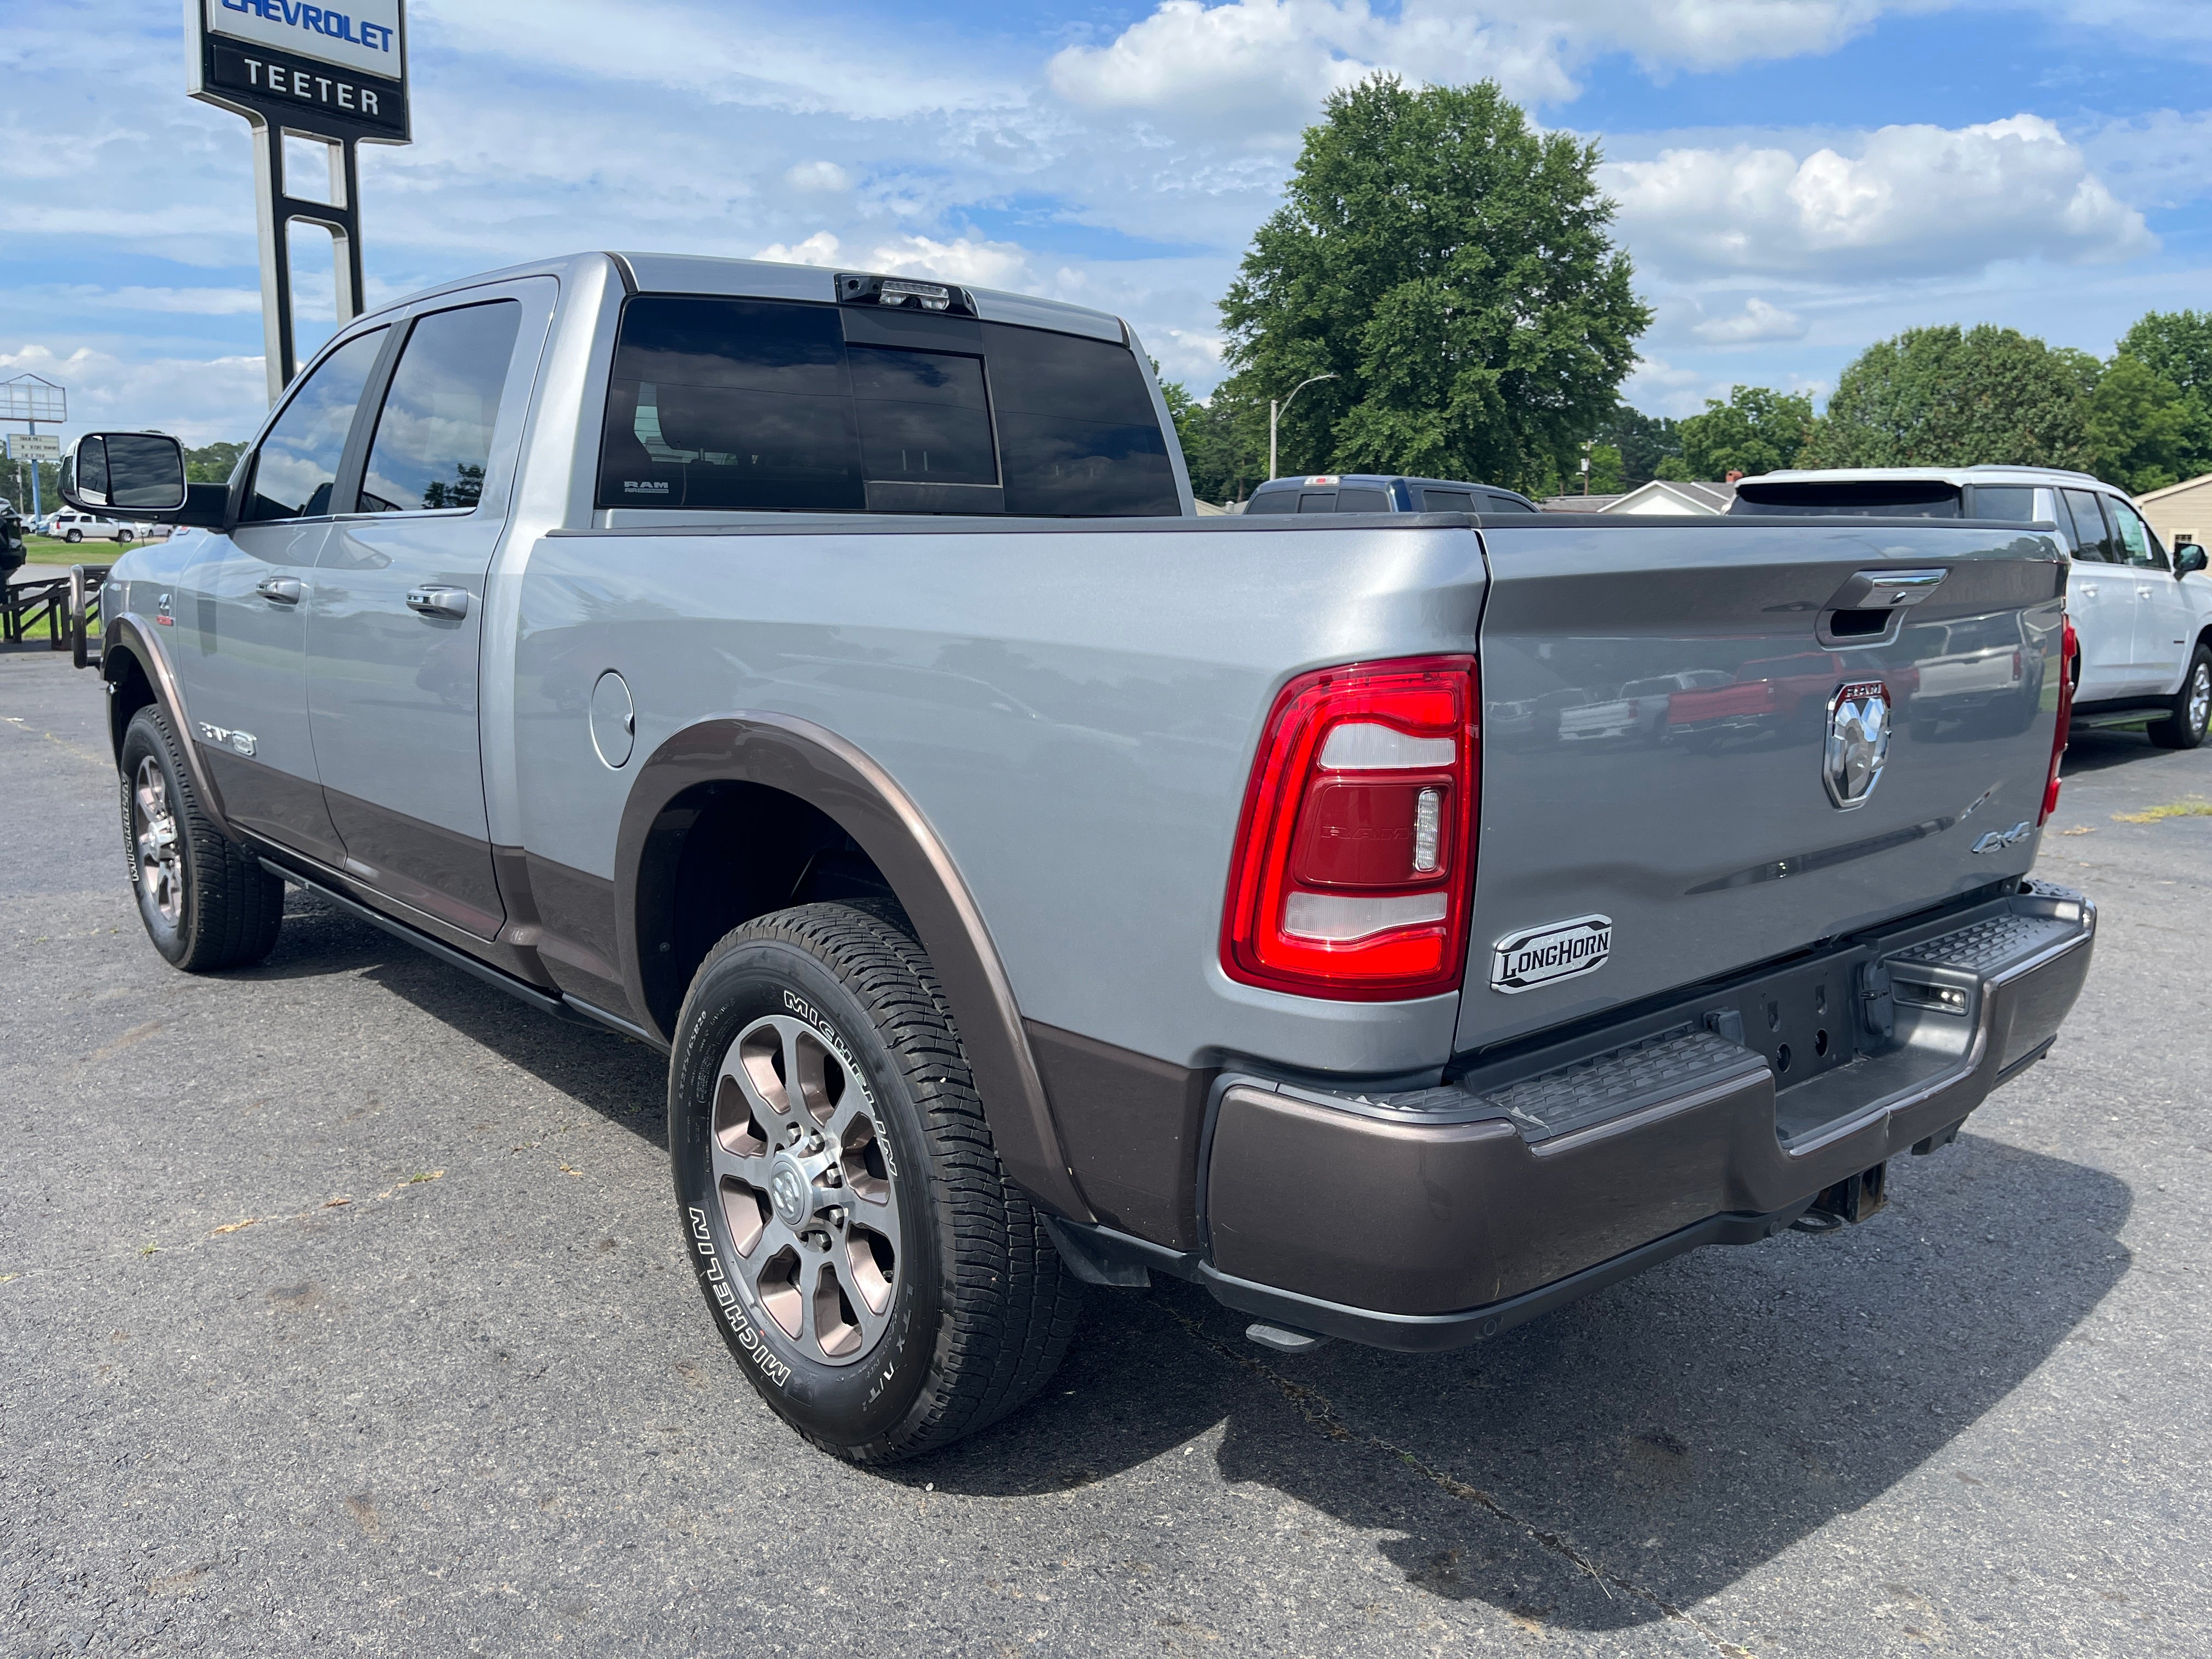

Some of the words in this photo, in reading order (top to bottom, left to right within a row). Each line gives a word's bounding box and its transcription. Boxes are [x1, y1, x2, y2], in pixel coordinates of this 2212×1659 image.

[244, 59, 379, 116] TEETER
[1846, 684, 1882, 697] RAM
[1321, 826, 1410, 840] RAM
[1500, 931, 1610, 980] LONGHORN
[1532, 928, 1587, 947] LIMITED
[783, 990, 898, 1177] MICHELIN
[689, 1207, 791, 1387] MICHELIN
